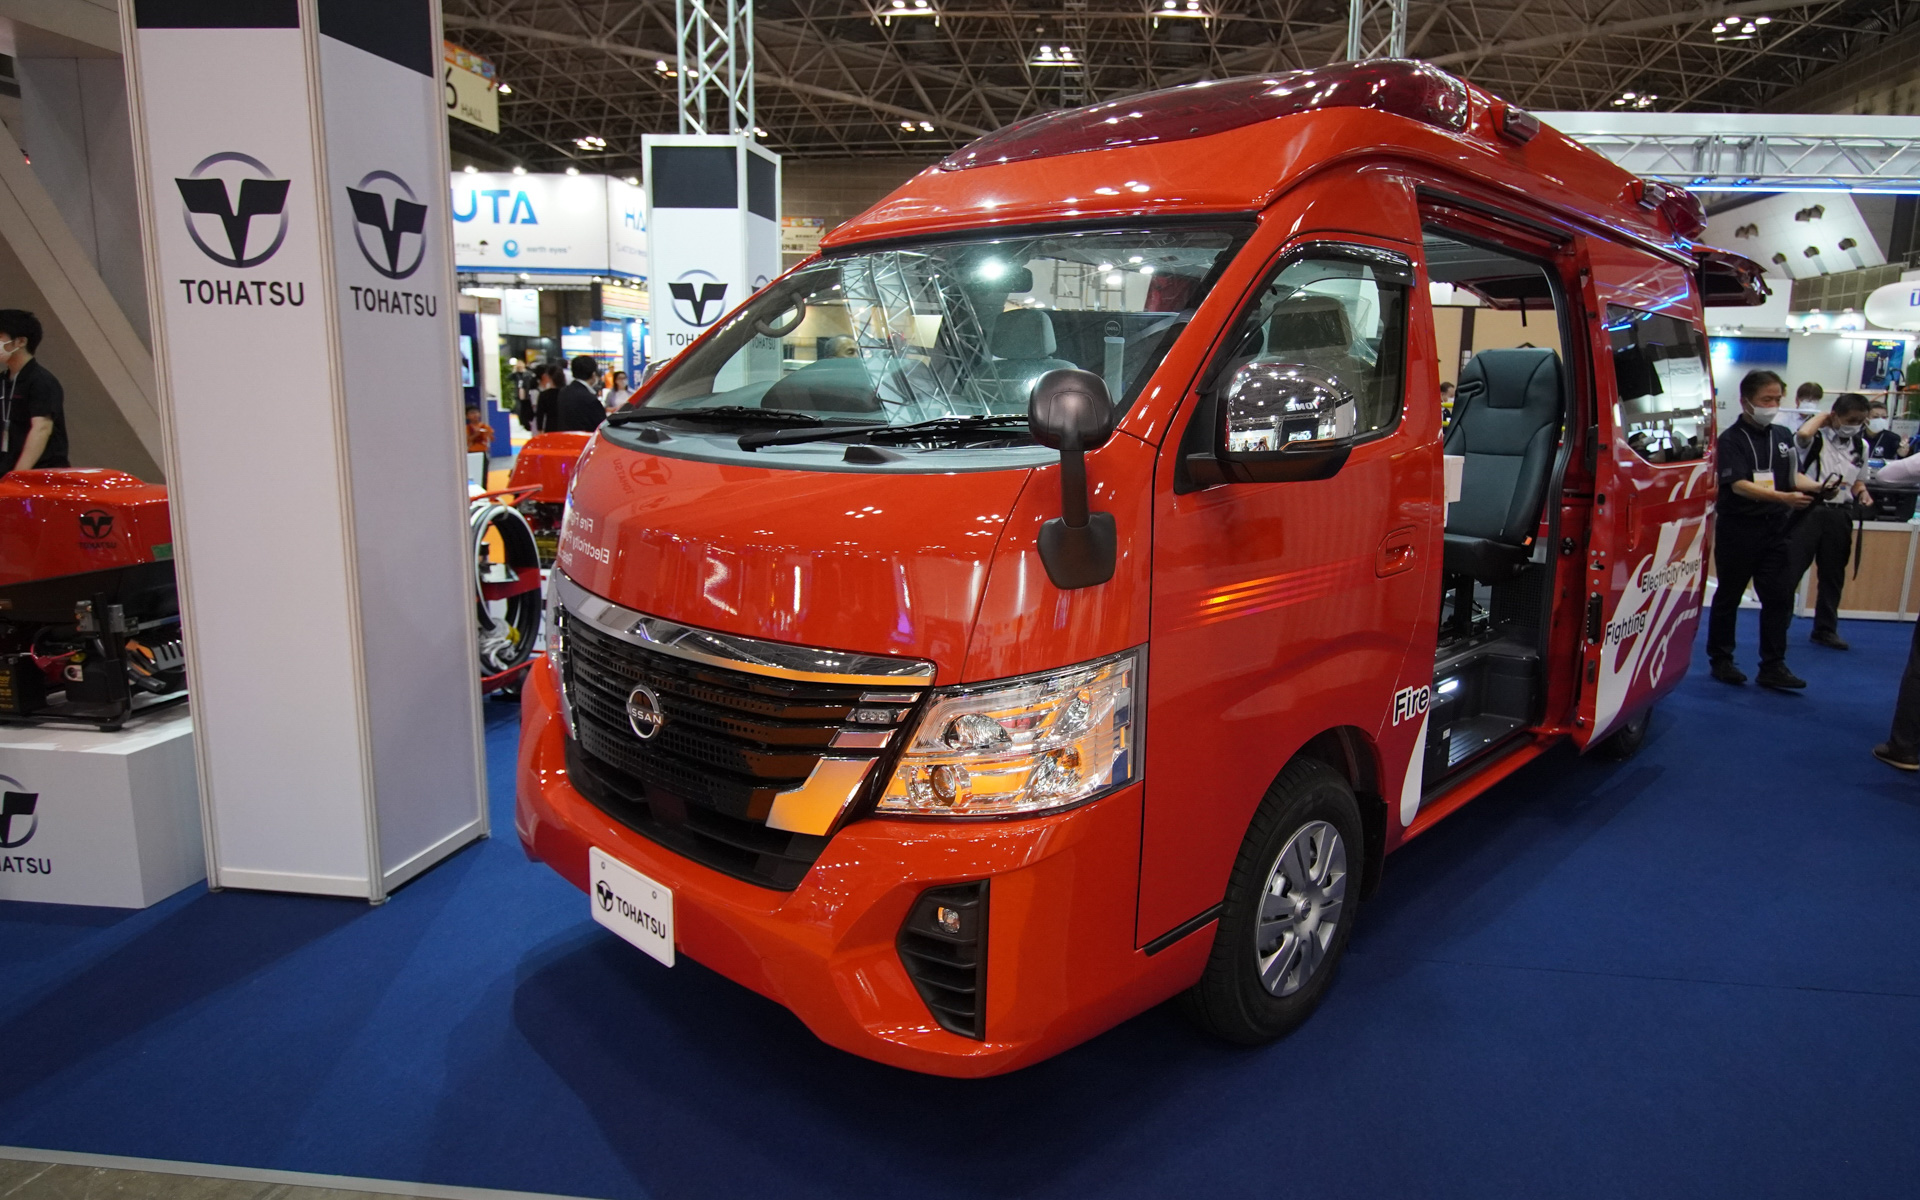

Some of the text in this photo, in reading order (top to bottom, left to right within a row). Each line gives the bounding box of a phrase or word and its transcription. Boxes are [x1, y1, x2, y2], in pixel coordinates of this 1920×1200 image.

[461, 103, 482, 122] HALL
[179, 279, 305, 307] TOHATSU
[349, 285, 437, 317] TOHATSU
[666, 333, 699, 346] TOH
[78, 541, 117, 550] TOHATSU
[1641, 558, 1701, 594] Electricity Power
[1604, 612, 1646, 646] Fighting
[1394, 688, 1429, 723] Fire
[0, 855, 52, 875] ATSU
[614, 895, 667, 940] TOHATSU
